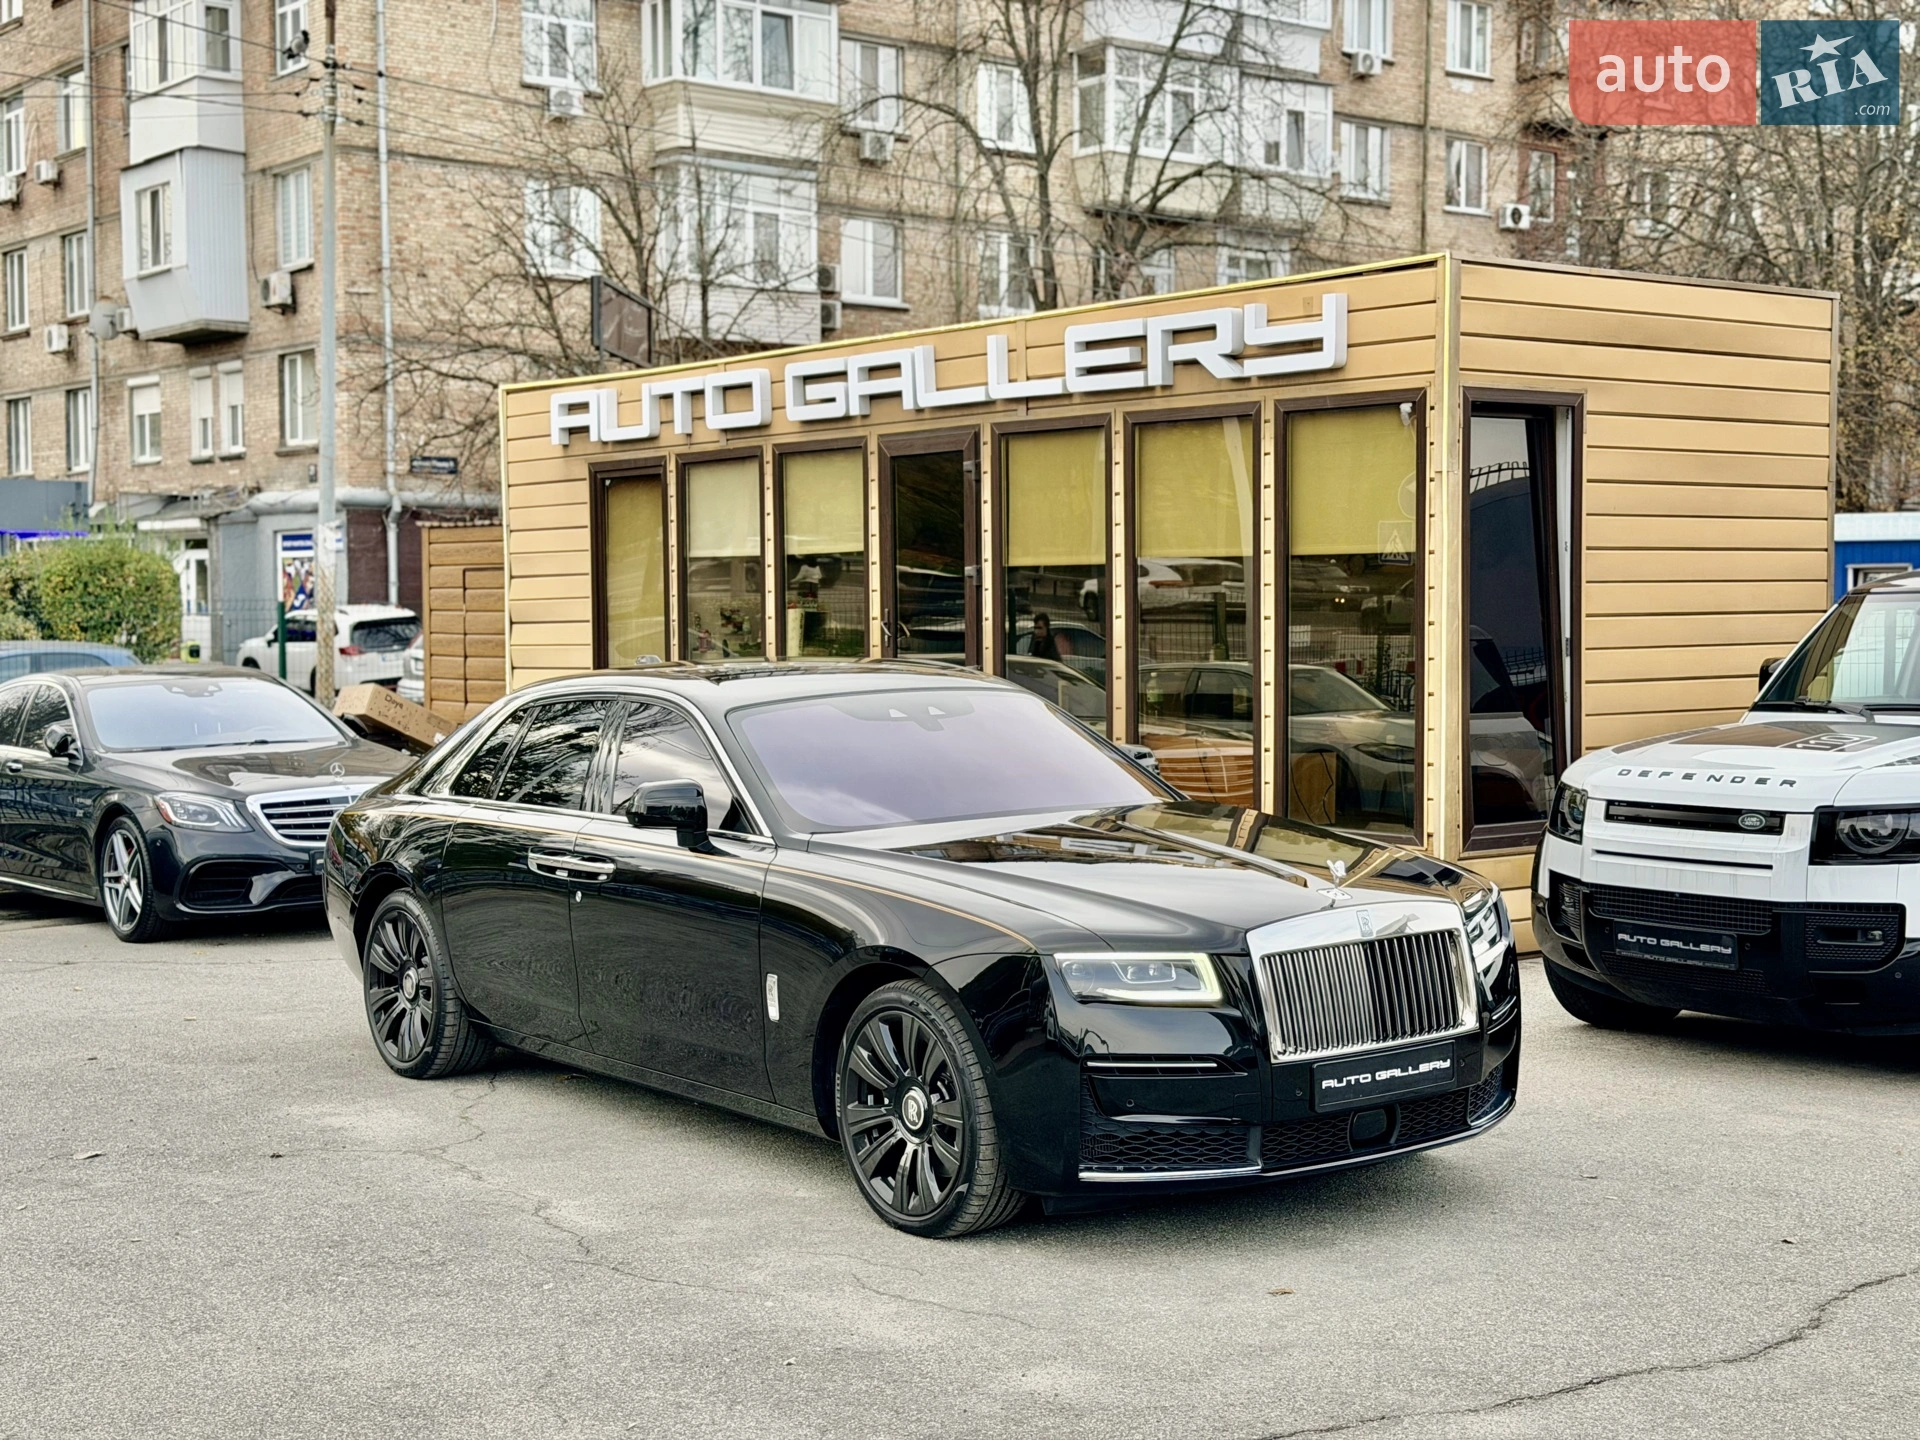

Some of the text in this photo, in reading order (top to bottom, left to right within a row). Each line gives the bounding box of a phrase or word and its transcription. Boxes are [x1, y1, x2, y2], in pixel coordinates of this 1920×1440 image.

[550, 292, 1349, 446] AUTO GALLERY
[1617, 768, 1797, 788] DEFENDER
[1617, 933, 1658, 945] AUTO
[1659, 939, 1733, 955] GALLERY
[1321, 1058, 1451, 1090] AUTO GALLERY
